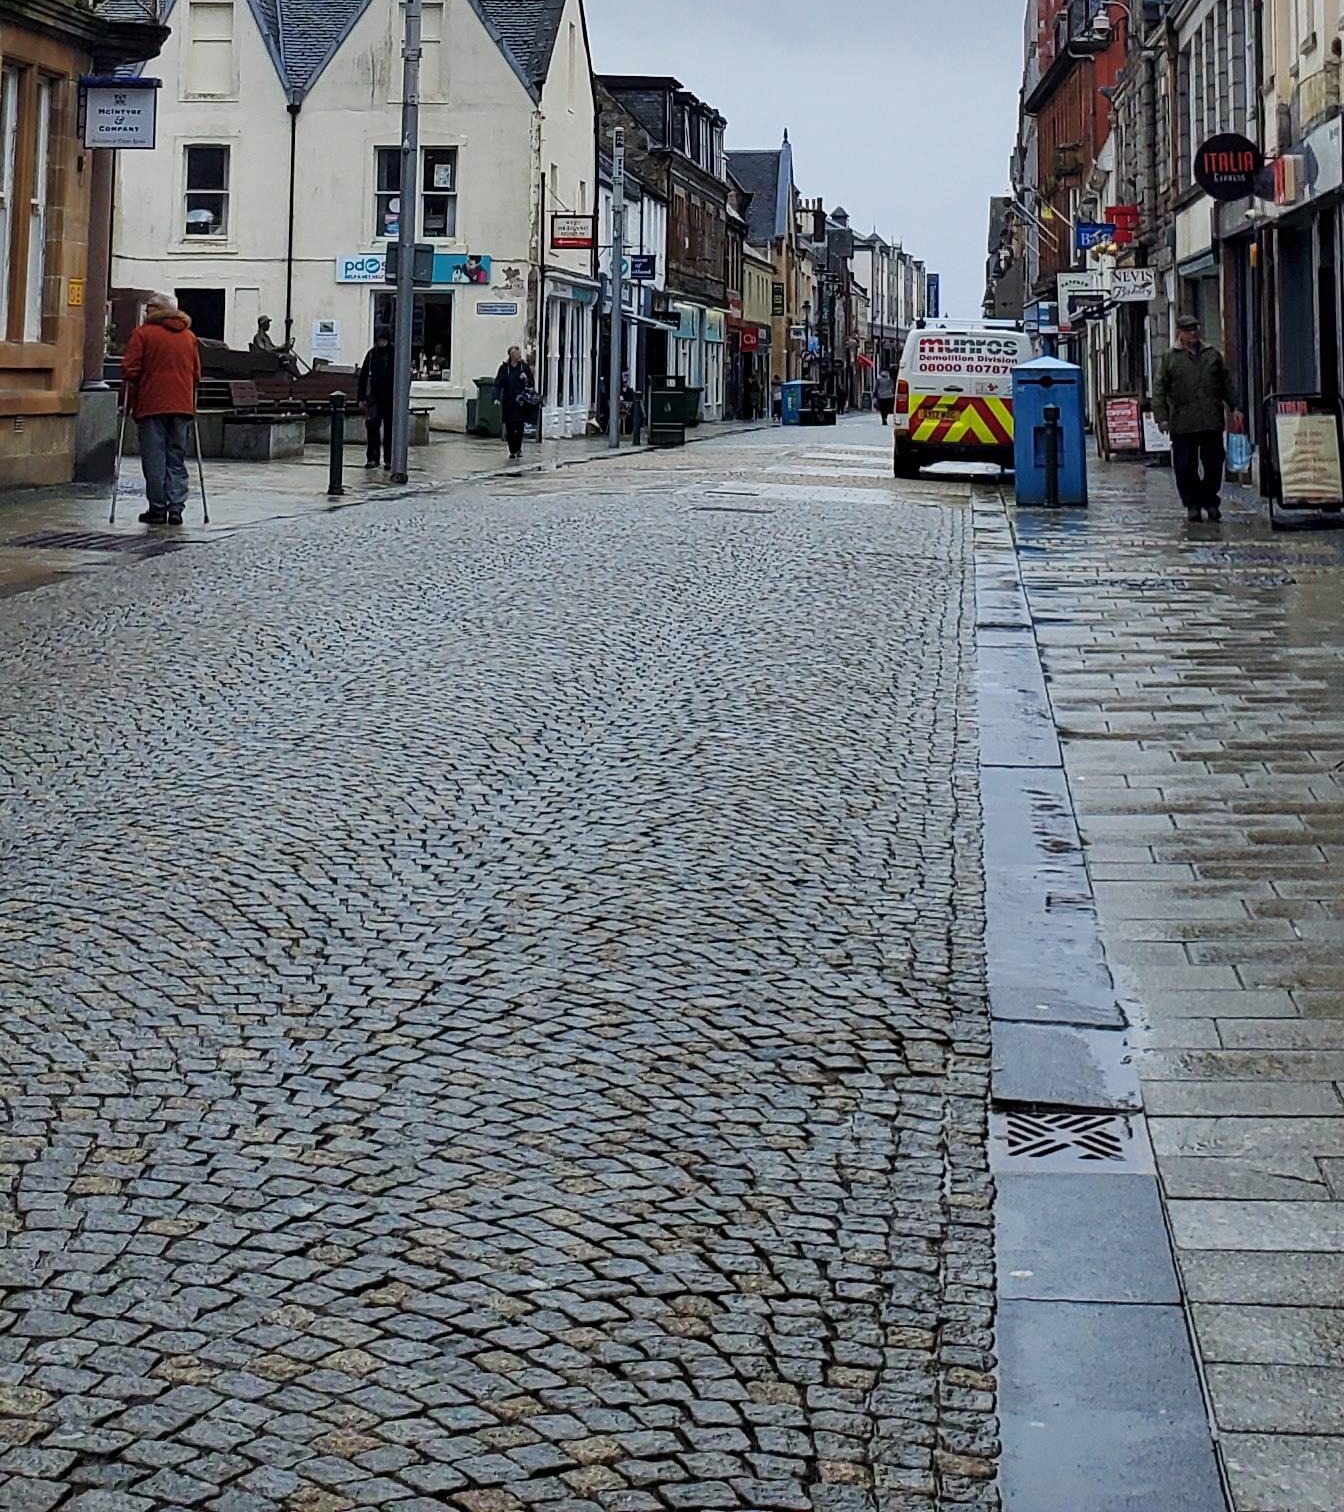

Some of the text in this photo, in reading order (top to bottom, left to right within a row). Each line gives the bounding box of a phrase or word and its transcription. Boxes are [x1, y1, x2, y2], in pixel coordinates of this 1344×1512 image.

[114, 116, 125, 125] &
[1203, 151, 1254, 174] ITALIA
[1112, 270, 1154, 283] NEVIS
[919, 338, 1018, 356] munros
[919, 354, 1018, 364] Demolition Division
[919, 364, 1013, 374] 08000 80787
